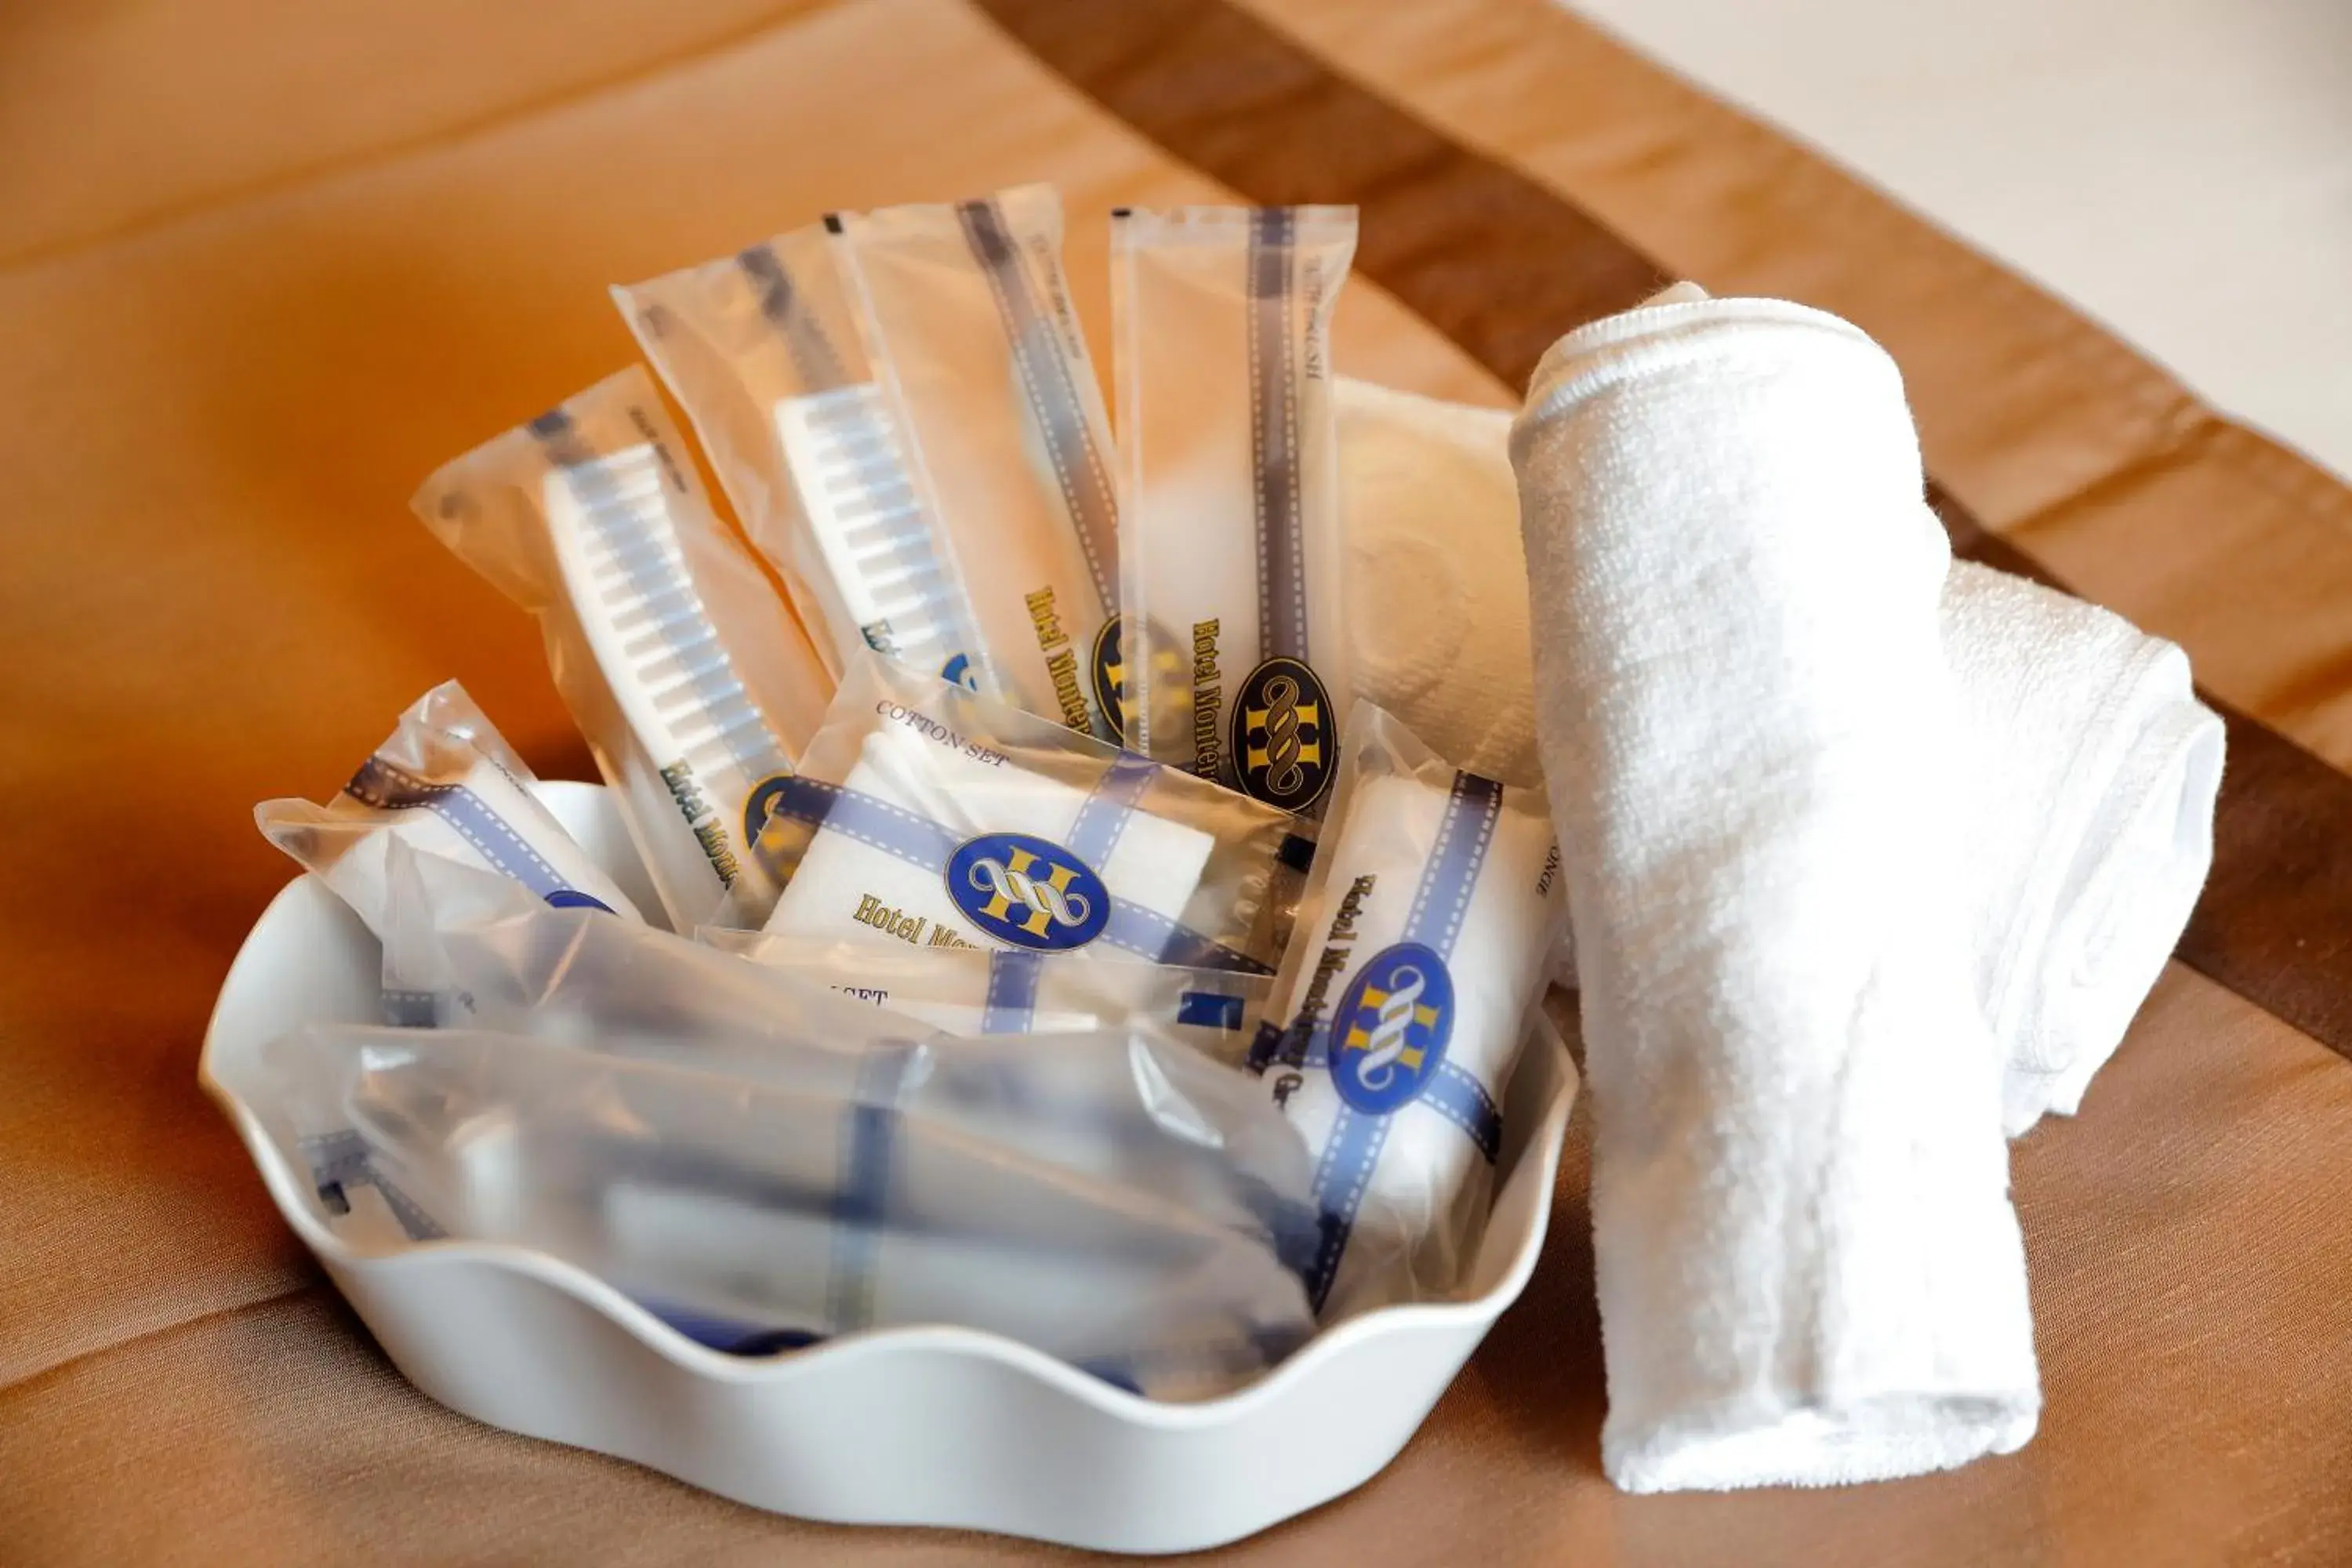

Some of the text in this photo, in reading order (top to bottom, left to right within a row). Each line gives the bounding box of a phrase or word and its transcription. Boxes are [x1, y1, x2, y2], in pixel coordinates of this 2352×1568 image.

[1025, 586, 1069, 652] Hotel
[1193, 618, 1221, 686] Hotel
[877, 700, 1010, 768] COTTON SET
[1536, 834, 1560, 898] ONGE
[853, 893, 927, 944] Hotel
